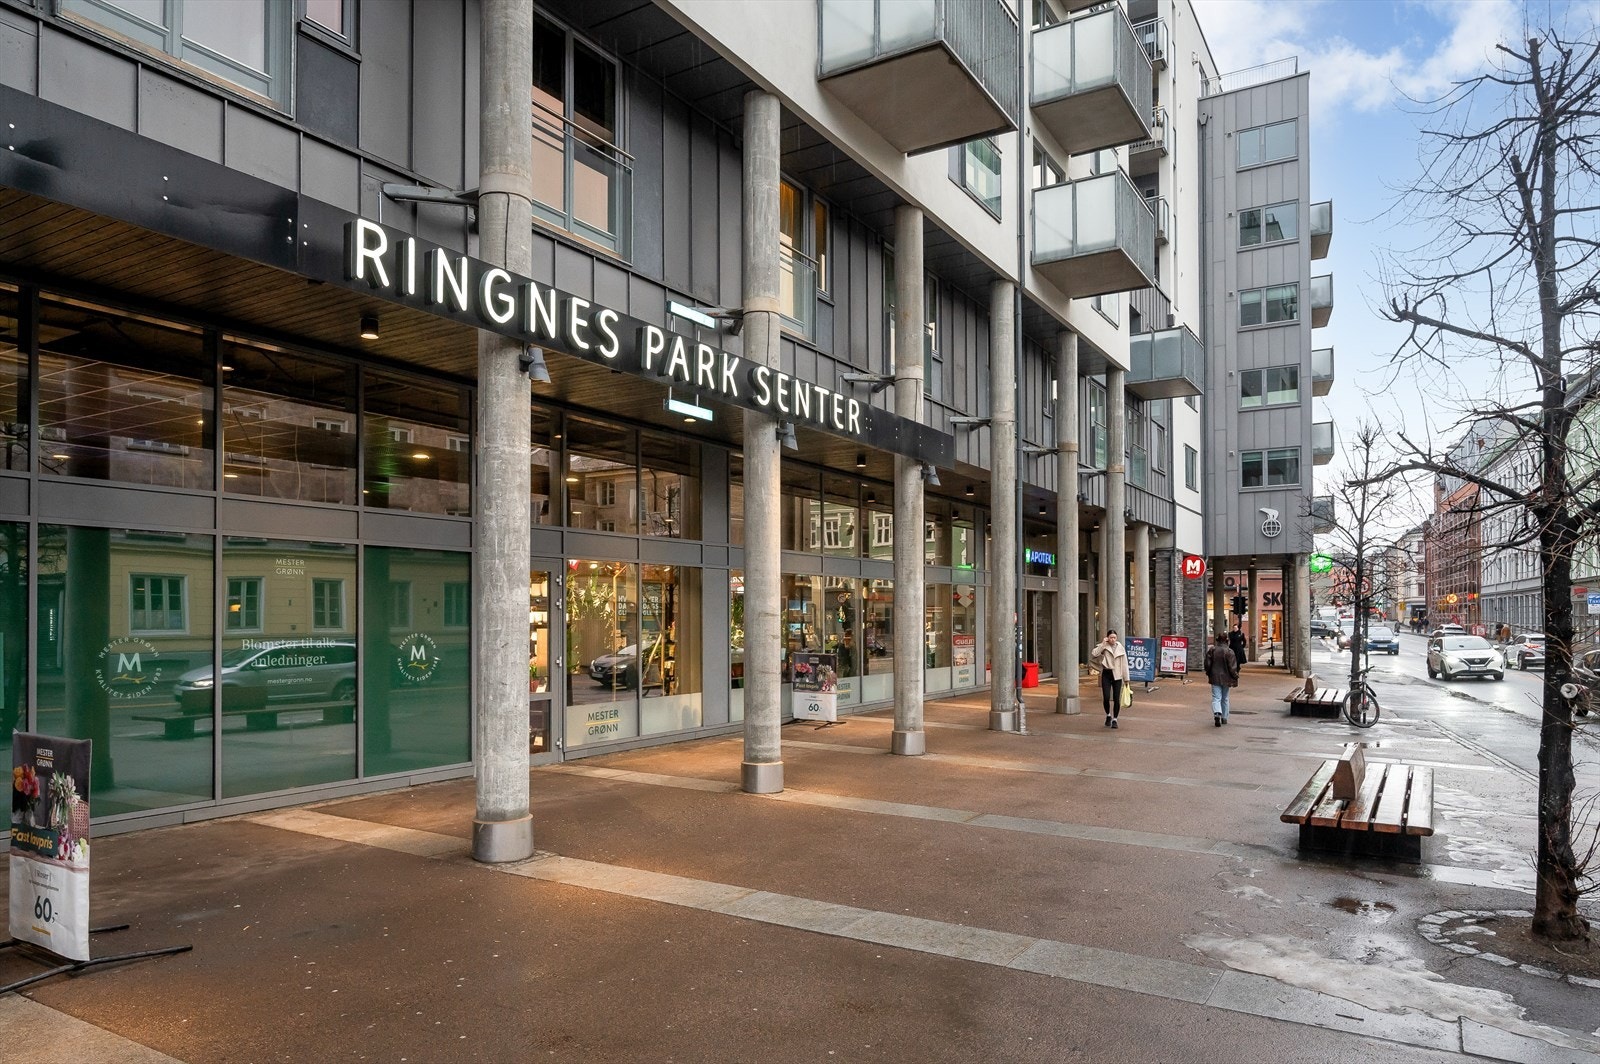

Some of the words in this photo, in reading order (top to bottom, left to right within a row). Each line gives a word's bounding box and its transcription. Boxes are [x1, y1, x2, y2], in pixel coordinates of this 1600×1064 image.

[355, 218, 620, 358] RINGNES
[645, 325, 739, 397] PARK
[755, 365, 861, 435] SENTER
[275, 558, 305, 566] MESTER
[1031, 551, 1052, 564] APOTEK
[275, 567, 304, 575] GRØNN
[1187, 560, 1200, 571] M
[1263, 592, 1283, 606] SK
[98, 637, 129, 658] MESTER
[241, 638, 298, 651] Blomster
[301, 637, 314, 649] til
[315, 637, 336, 649] alle
[399, 633, 418, 650] MESTER
[1164, 640, 1185, 648] TILBUD
[410, 645, 426, 661] M
[117, 653, 142, 672] M
[251, 654, 328, 668] anledninger.
[95, 669, 124, 698] KVALITET
[126, 685, 152, 699] SIDEN
[587, 709, 619, 721] MESTER
[587, 723, 619, 736] GRØNN
[11, 828, 29, 844] Fast
[30, 832, 53, 850] lavpris
